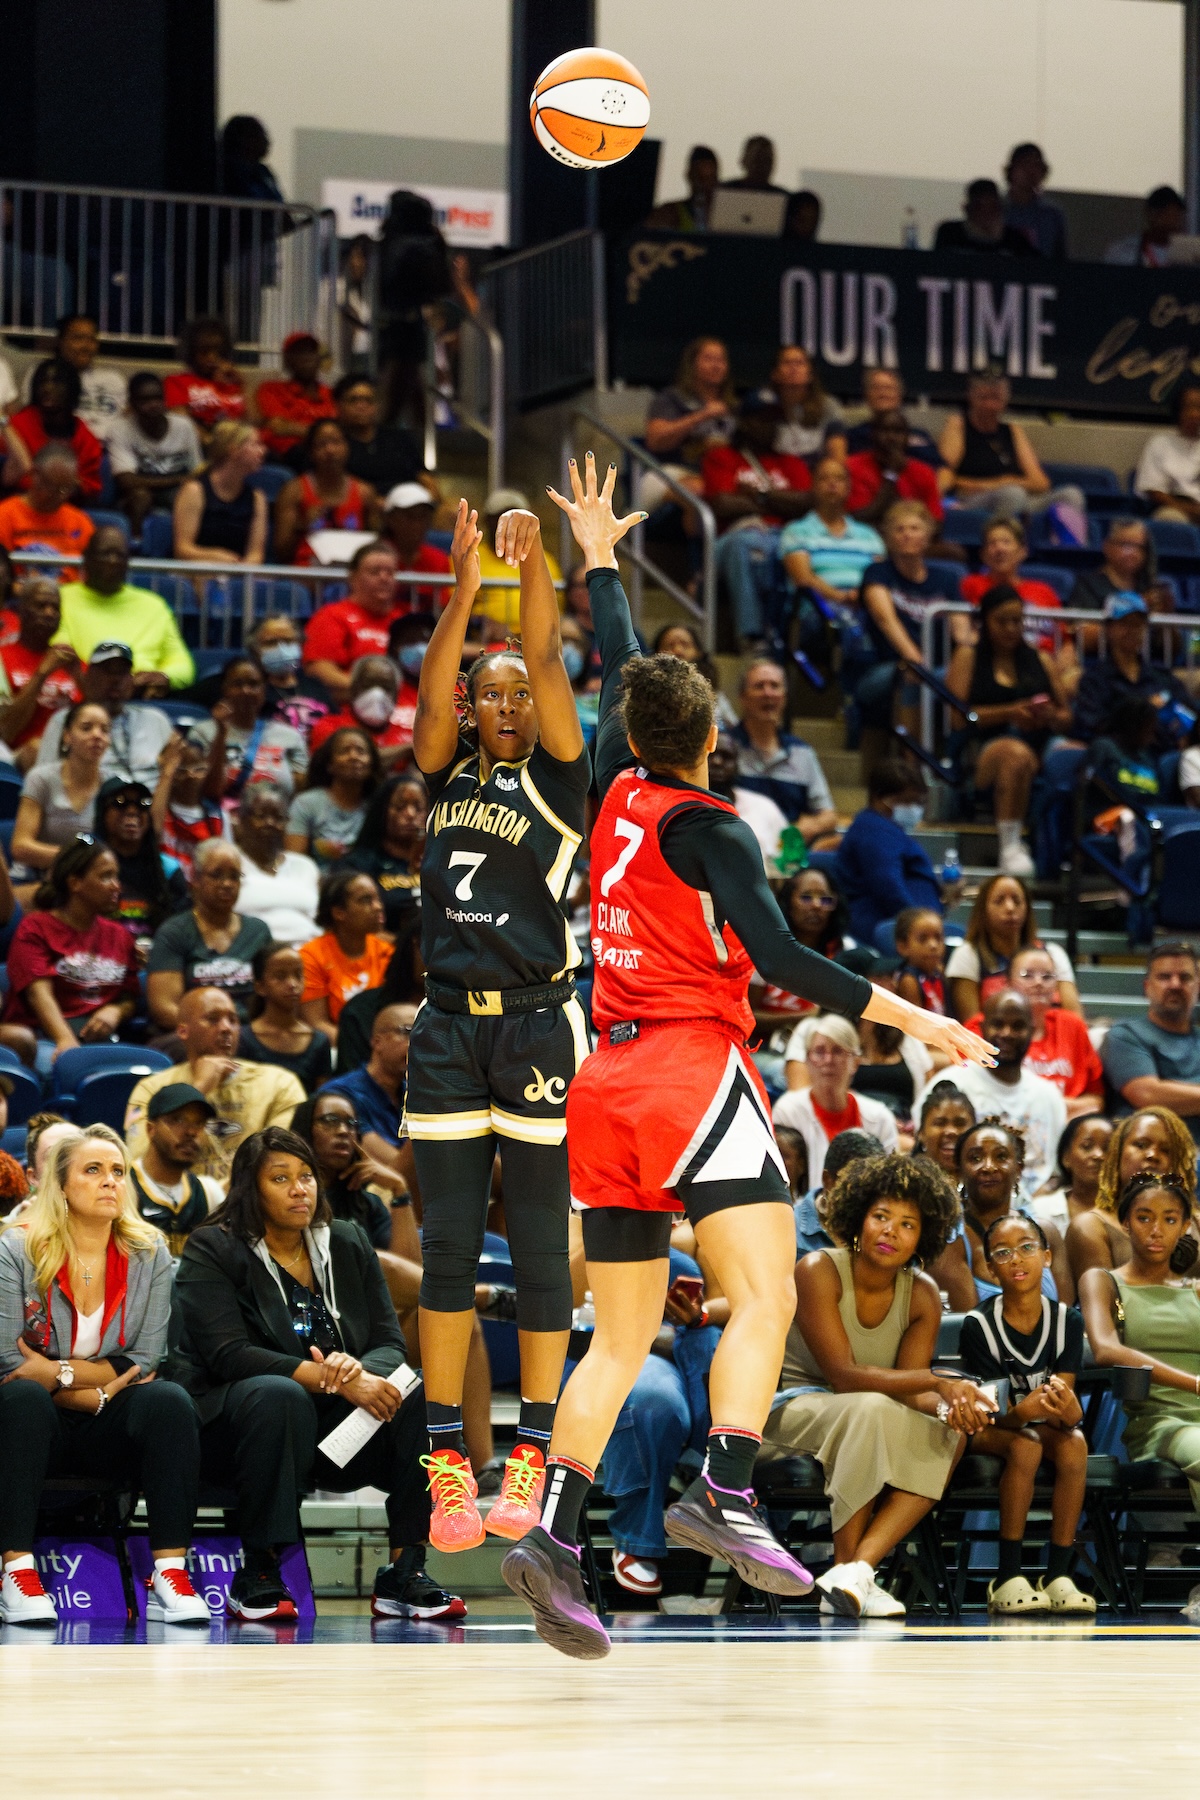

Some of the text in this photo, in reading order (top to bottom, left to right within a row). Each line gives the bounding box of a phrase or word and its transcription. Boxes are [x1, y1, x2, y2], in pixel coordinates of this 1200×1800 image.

[780, 266, 1057, 380] OUR TIME
[601, 816, 645, 898] 7
[447, 850, 488, 902] 7
[597, 901, 633, 937] CLARK
[603, 947, 643, 970] AT&T
[34, 1549, 83, 1580] ity
[185, 1547, 246, 1573] finit
